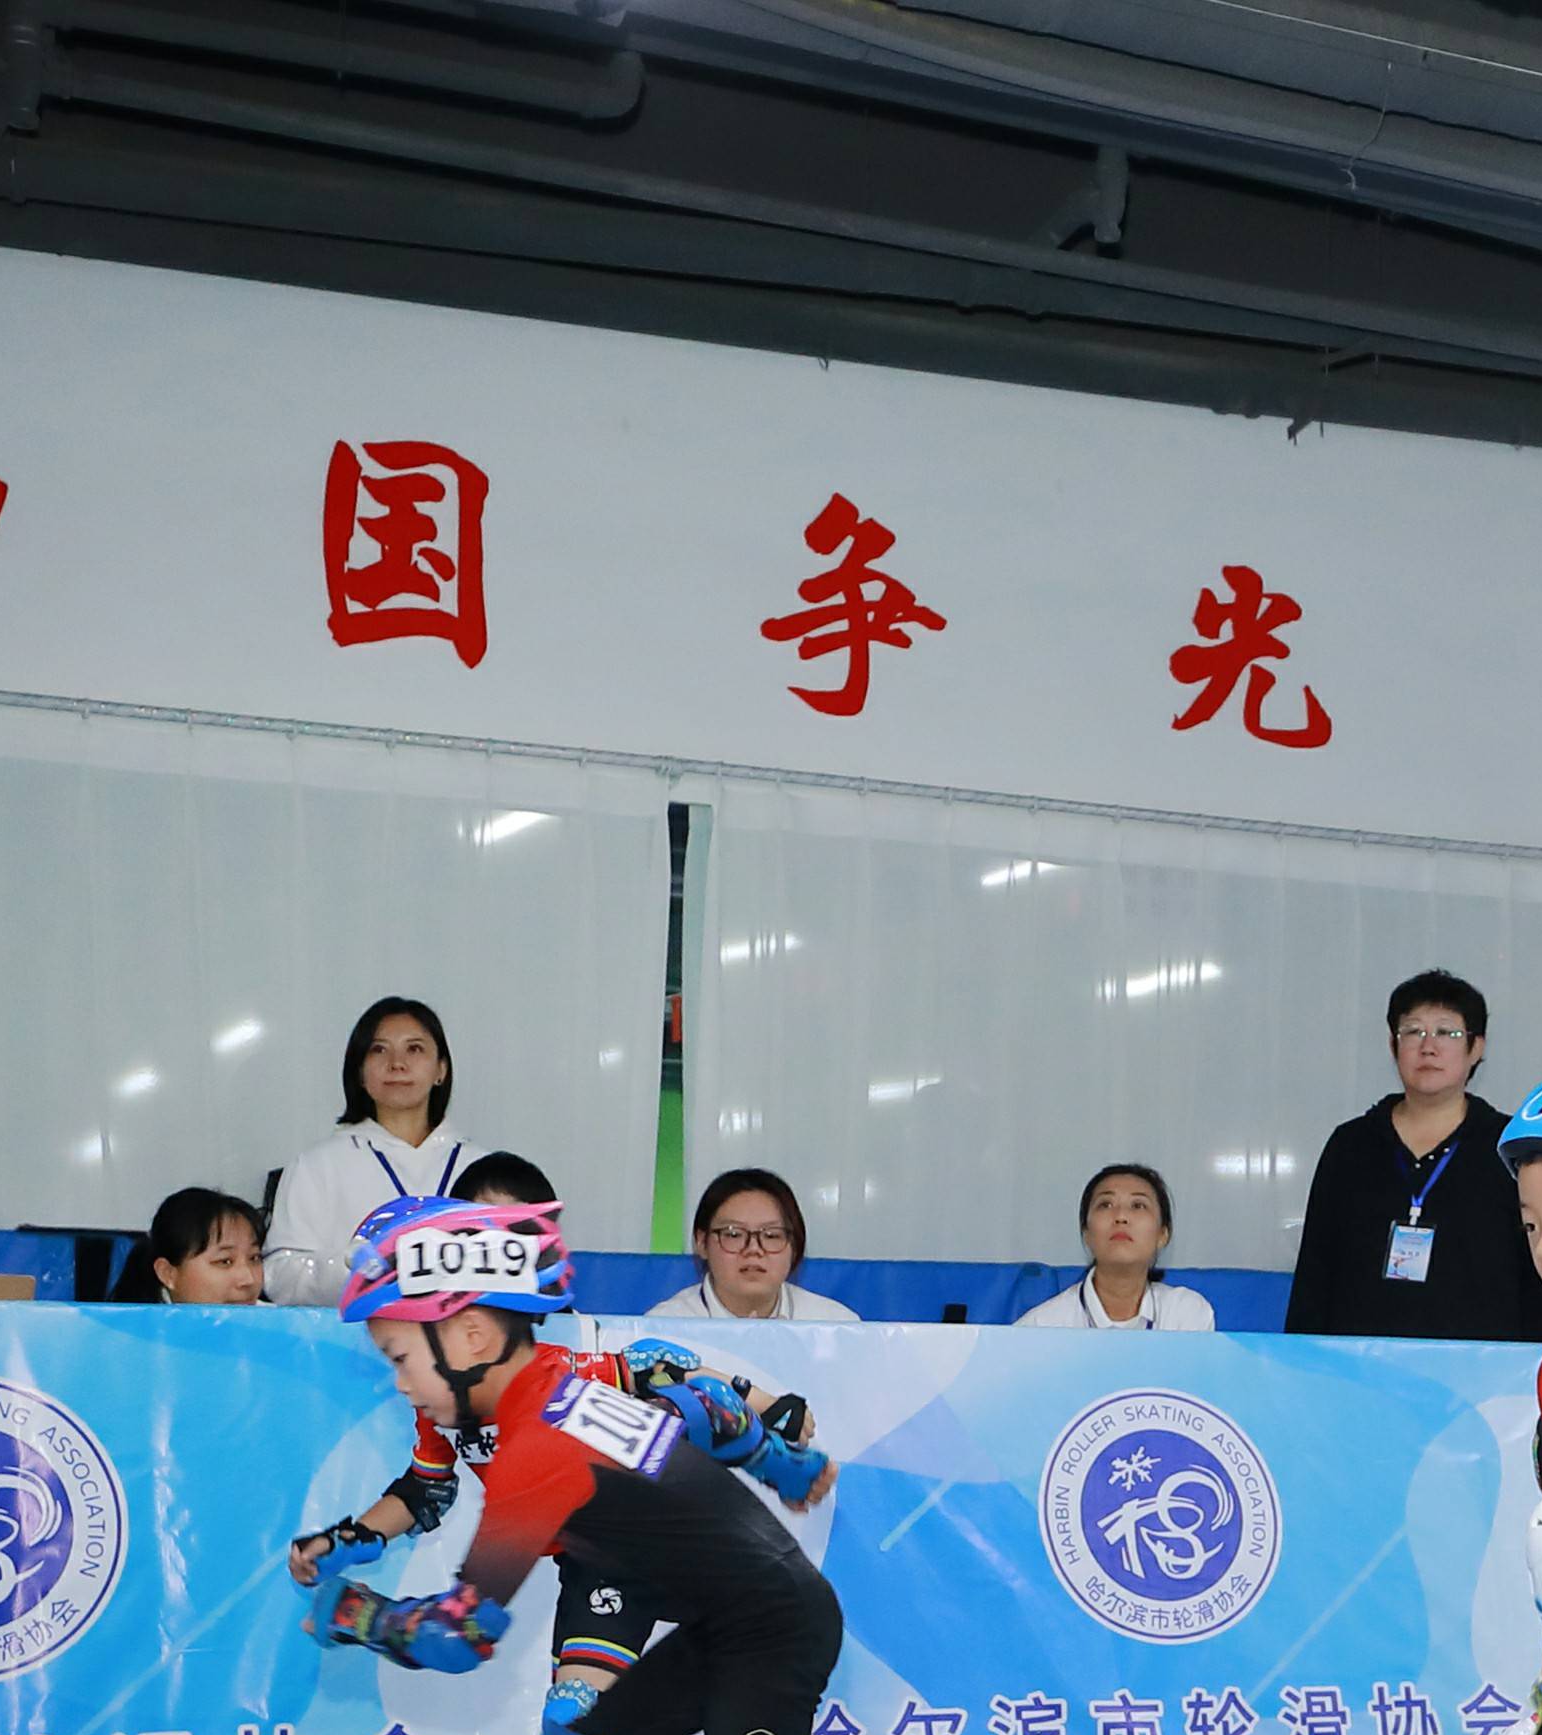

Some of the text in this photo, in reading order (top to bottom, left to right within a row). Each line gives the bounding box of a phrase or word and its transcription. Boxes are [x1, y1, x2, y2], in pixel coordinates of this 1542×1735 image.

[410, 1240, 526, 1277] 1019
[38, 1426, 107, 1579] ASSOCIATION
[1056, 1404, 1266, 1565] HARBIN ROLLER SKATING ASSOCIATION
[1085, 1573, 1252, 1630] 哈尔滨市轮滑协会
